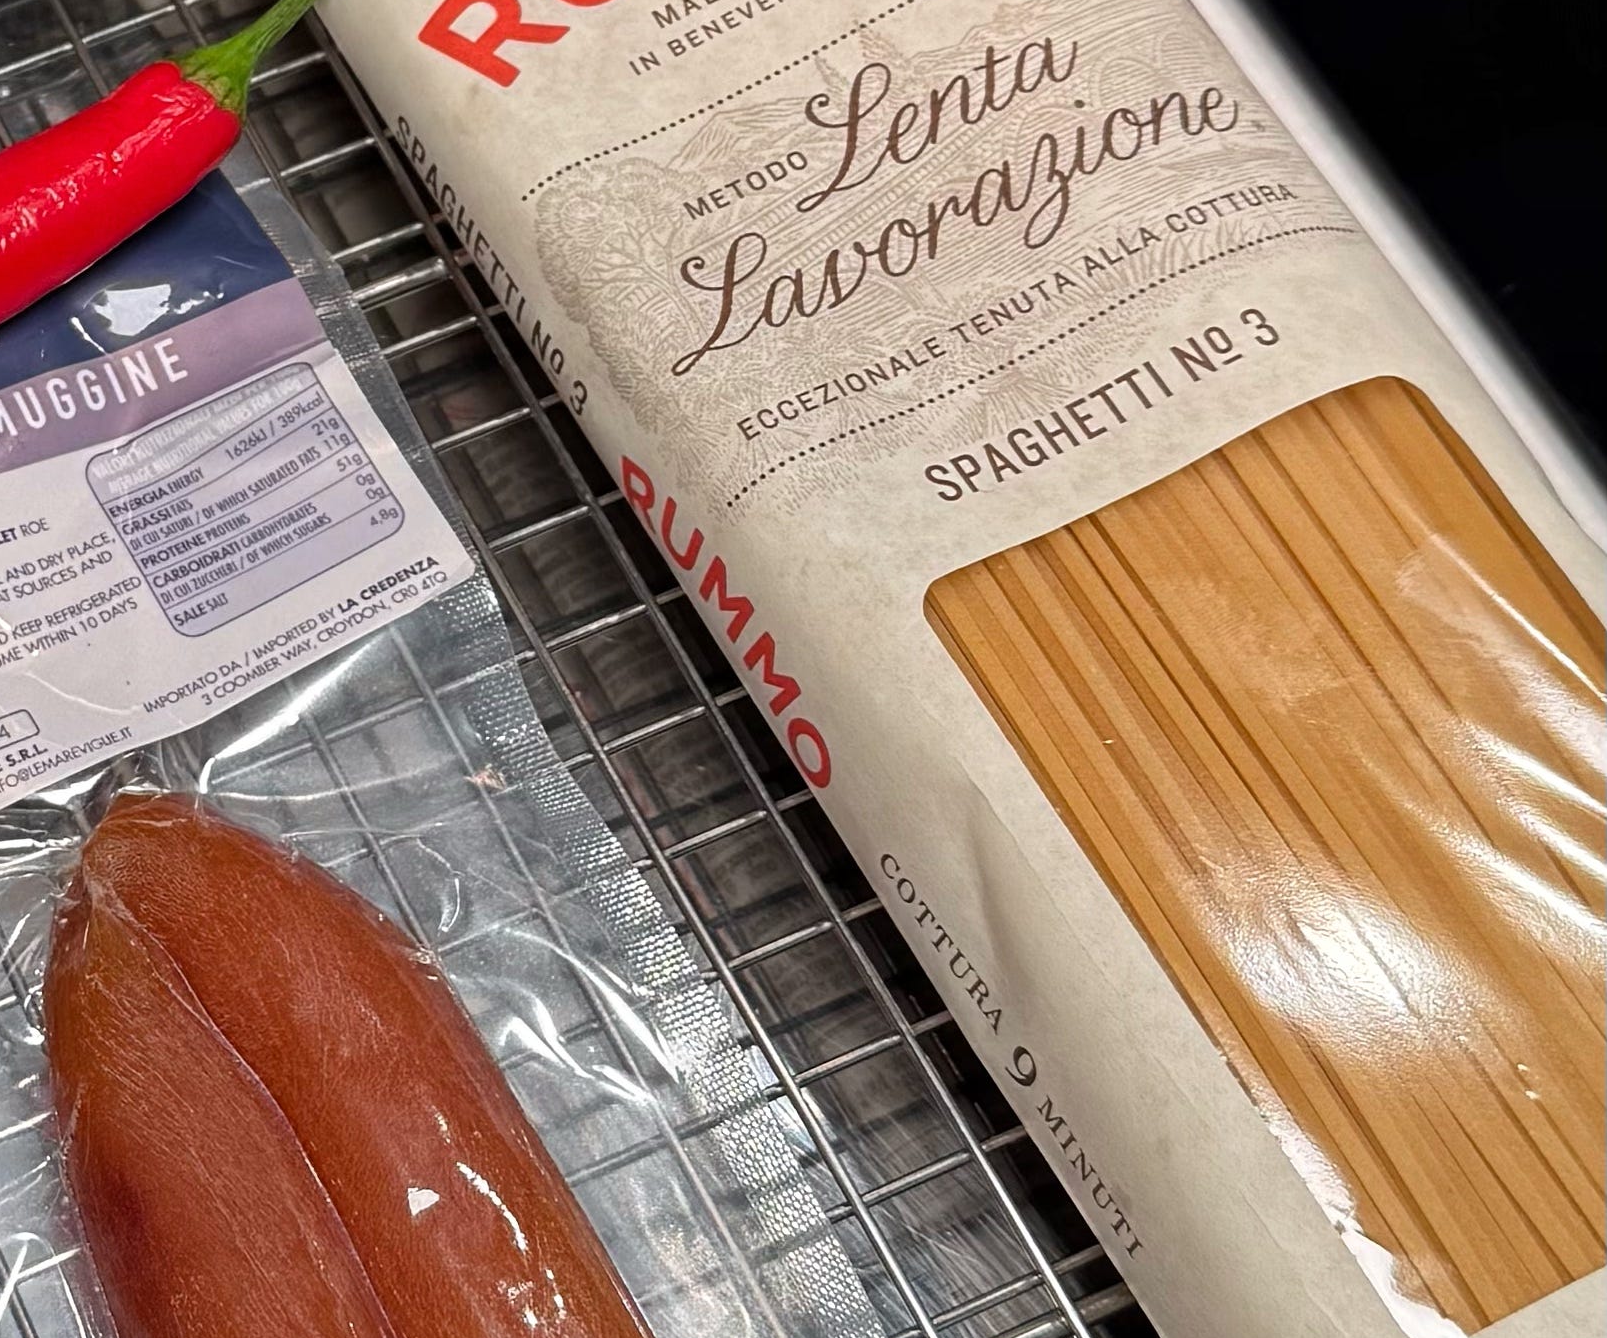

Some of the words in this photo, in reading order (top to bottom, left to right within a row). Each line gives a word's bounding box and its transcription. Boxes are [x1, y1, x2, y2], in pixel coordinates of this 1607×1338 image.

[628, 50, 661, 77] IN
[682, 149, 809, 221] METODO
[795, 36, 1078, 213] Lenta
[395, 115, 527, 327] SPAGHETTI
[567, 378, 590, 418] 3
[670, 86, 1240, 377] Lavorazione
[736, 334, 949, 442] ECCEZIONALE
[949, 272, 1079, 345] TENUTA
[1082, 226, 1163, 278] ALLA
[1163, 182, 1300, 235] COTTURA
[107, 484, 170, 519] ENERGIA
[165, 466, 206, 494] ENERGY
[276, 391, 326, 430] 389kcal
[923, 360, 1174, 503] SPAGHETTI
[1238, 307, 1280, 347] 3
[18, 516, 51, 537] ROE
[119, 505, 175, 538] GRASSI
[168, 496, 195, 516] FATS
[310, 414, 341, 437] 21g
[139, 532, 207, 570] PROTEINE
[203, 511, 252, 542] PROTEINS
[333, 450, 365, 473] 51g
[1, 559, 38, 583] AND
[35, 549, 67, 571] DRY
[65, 528, 117, 560] PLACE,
[8, 615, 45, 640] KEEP
[42, 573, 144, 628] REFRIGERATED
[10, 564, 79, 599] SOURCES
[76, 548, 115, 574] AND
[150, 538, 243, 590] CARBOIDRATI
[172, 601, 209, 627] SALE
[204, 591, 230, 612] SALT
[366, 503, 401, 528] 4,8g
[22, 623, 79, 656] WITHIN
[78, 614, 100, 633] 10
[97, 595, 140, 624] DAYS
[141, 669, 220, 714] IMPORTATO
[217, 656, 243, 678] DA
[250, 616, 319, 661] IMPORTED
[316, 606, 339, 626] BY
[335, 595, 360, 616] LA
[357, 553, 440, 603] CREDENZA
[210, 654, 283, 701] COOMBER
[281, 636, 319, 664] WAY,
[314, 597, 391, 645] CROYDON,
[618, 454, 833, 790] RUMMO
[4, 739, 49, 768] S.R.L.
[879, 852, 1004, 1036] COTTURA
[1004, 1045, 1038, 1087] 9
[1036, 1094, 1145, 1260] MINUTI
